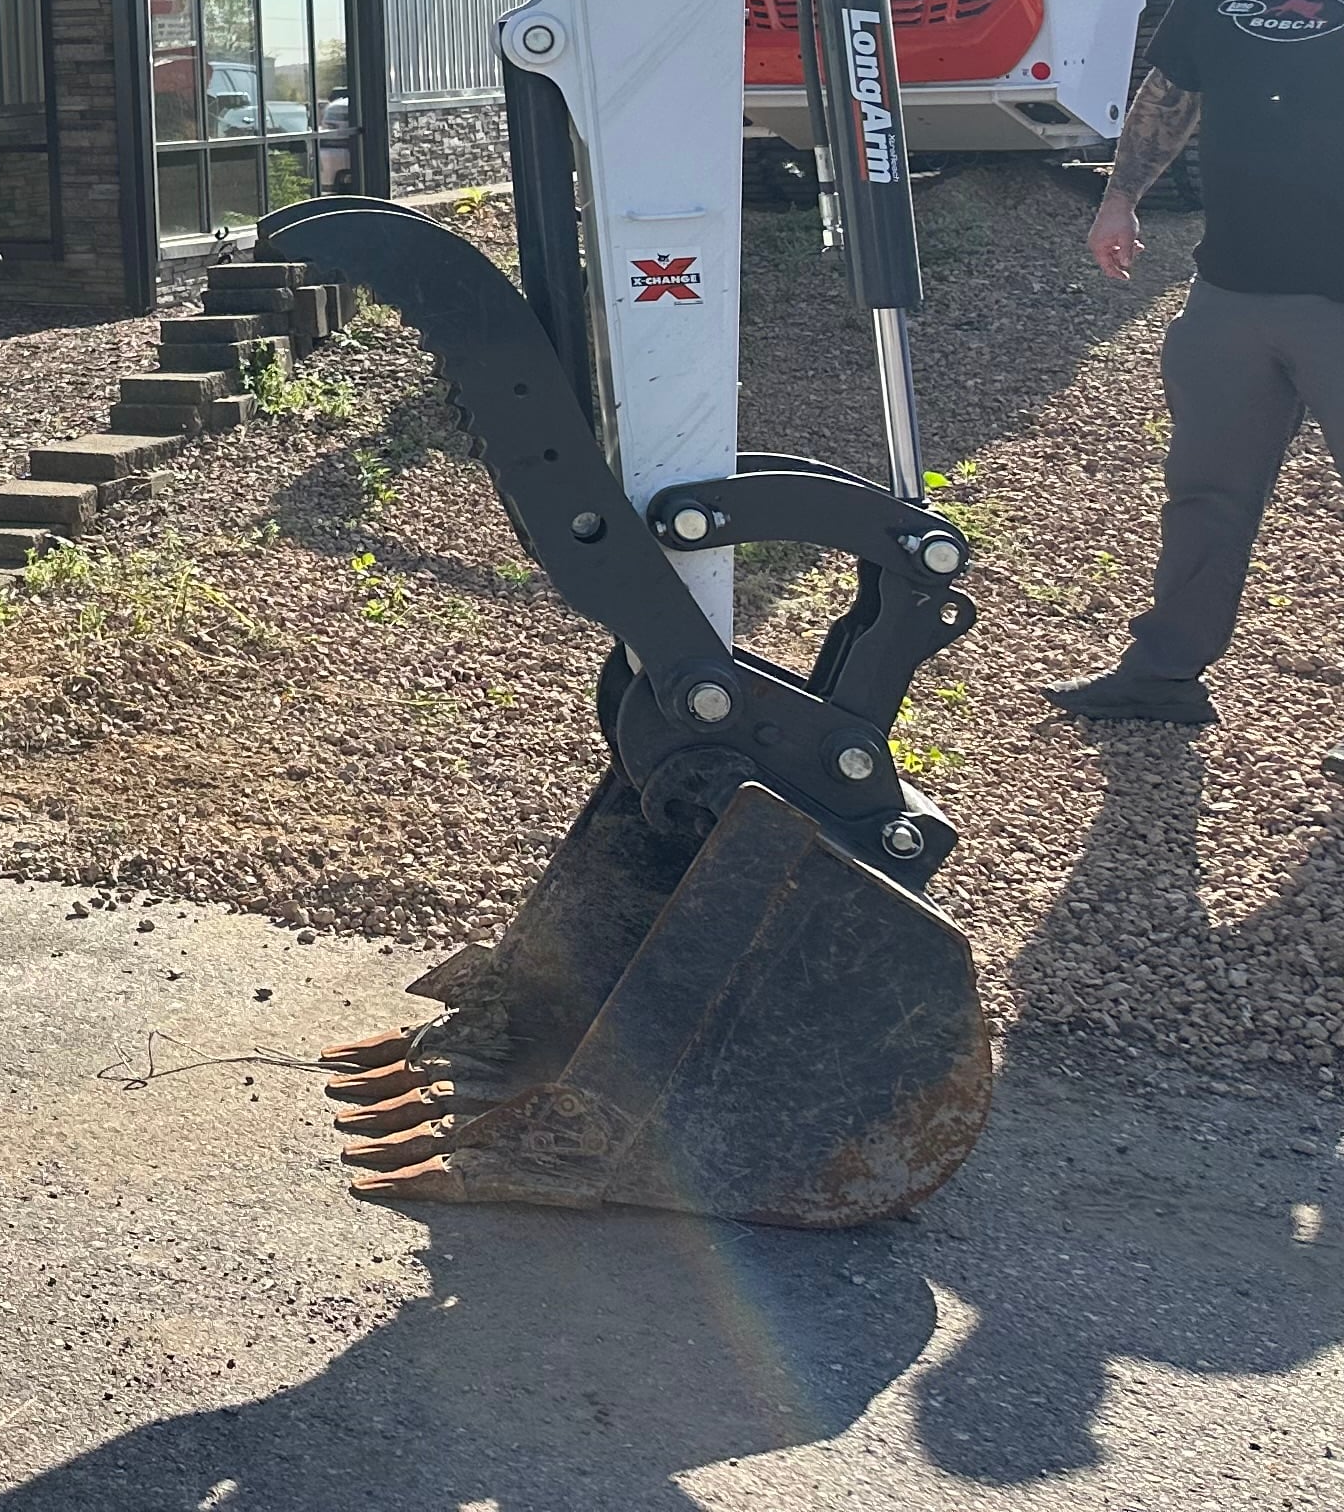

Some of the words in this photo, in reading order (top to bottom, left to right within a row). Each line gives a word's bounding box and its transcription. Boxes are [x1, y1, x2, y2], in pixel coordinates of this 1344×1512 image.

[1249, 18, 1328, 29] BOBCAT
[849, 8, 892, 183] LongArm
[633, 275, 698, 286] X-CHANGE
